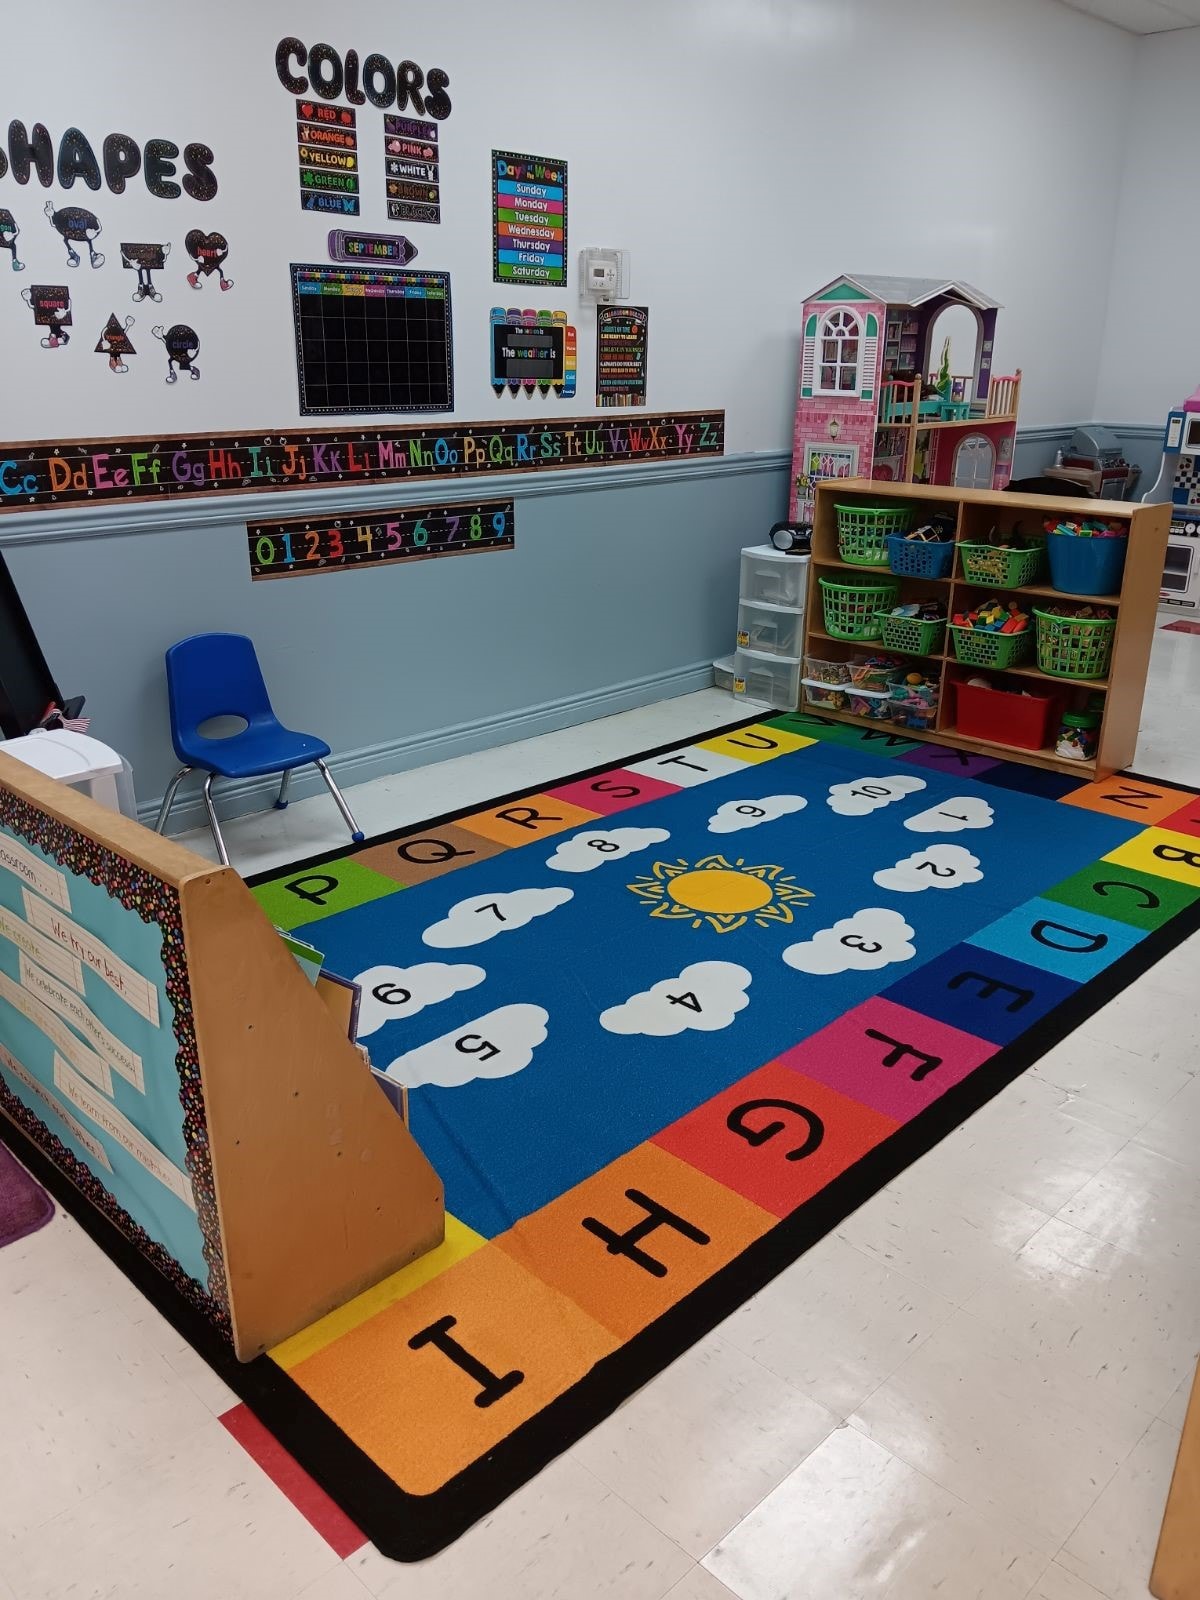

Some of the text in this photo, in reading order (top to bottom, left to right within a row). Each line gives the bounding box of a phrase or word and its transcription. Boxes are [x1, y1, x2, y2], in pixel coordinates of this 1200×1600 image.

[275, 36, 452, 121] COLORS
[317, 108, 336, 119] RED
[310, 130, 346, 144] ORANGE
[402, 142, 422, 155] PINK
[0, 118, 218, 202] HAPES
[309, 152, 347, 165] YELLOW
[314, 175, 345, 186] GREEN
[399, 165, 426, 177] WHITE
[535, 163, 563, 183] Week
[516, 183, 547, 198] Sunday
[318, 197, 342, 209] BLUE
[514, 197, 548, 211] Monday
[68, 218, 88, 229] oval
[514, 211, 549, 225] Tuesday
[507, 224, 555, 240] Wednesday
[197, 247, 217, 258] heart
[348, 240, 399, 256] SEPTEMBER
[512, 238, 551, 252] Thursday
[518, 253, 545, 267] Friday
[512, 265, 550, 279] Saturday
[39, 300, 65, 309] square
[172, 339, 194, 349] circle
[502, 347, 556, 359] The weather is
[0, 460, 39, 495] Cc
[49, 457, 88, 491] Dd
[92, 453, 130, 489] Ee
[131, 453, 161, 486] Ff
[172, 451, 205, 487] Gg
[208, 448, 242, 479] Hh
[248, 446, 273, 477] Ii
[281, 445, 307, 480] Jj
[312, 444, 343, 473] Kk
[378, 440, 407, 469] Mm
[409, 438, 434, 467] Nn
[434, 437, 458, 465] Oo
[463, 436, 486, 469] Pp
[488, 434, 513, 466] Qq
[517, 433, 536, 461] Rr
[540, 431, 562, 458] Ss
[564, 431, 581, 457] Tt
[585, 430, 605, 455] Uu
[608, 428, 629, 453] Vv
[628, 427, 649, 452] Ww
[649, 426, 667, 450] Xx
[674, 424, 693, 453] Yy
[699, 423, 717, 446] Zz
[256, 511, 506, 565] 0 1 2 3 4 5 6 7 8 9
[726, 731, 779, 750] U
[657, 755, 709, 780] T
[590, 779, 642, 799] S
[850, 784, 892, 801] 10
[495, 806, 564, 830] R
[735, 803, 767, 819] 9
[938, 810, 969, 822] 1
[397, 837, 476, 865] Q
[586, 837, 620, 853] 8
[915, 860, 956, 879] 2
[283, 873, 341, 907] P
[1092, 880, 1160, 911] C
[474, 903, 508, 923] 7
[51, 917, 68, 942] We
[70, 931, 85, 960] try
[87, 951, 101, 969] our
[839, 933, 883, 954] 3
[1030, 919, 1109, 954] D
[371, 982, 412, 1006] 6
[947, 969, 1035, 1014] E
[666, 990, 704, 1014] 4
[454, 1033, 501, 1063] 5
[864, 1027, 944, 1082] F
[725, 1097, 825, 1162] G
[580, 1188, 711, 1279] H
[407, 1315, 525, 1408] I
